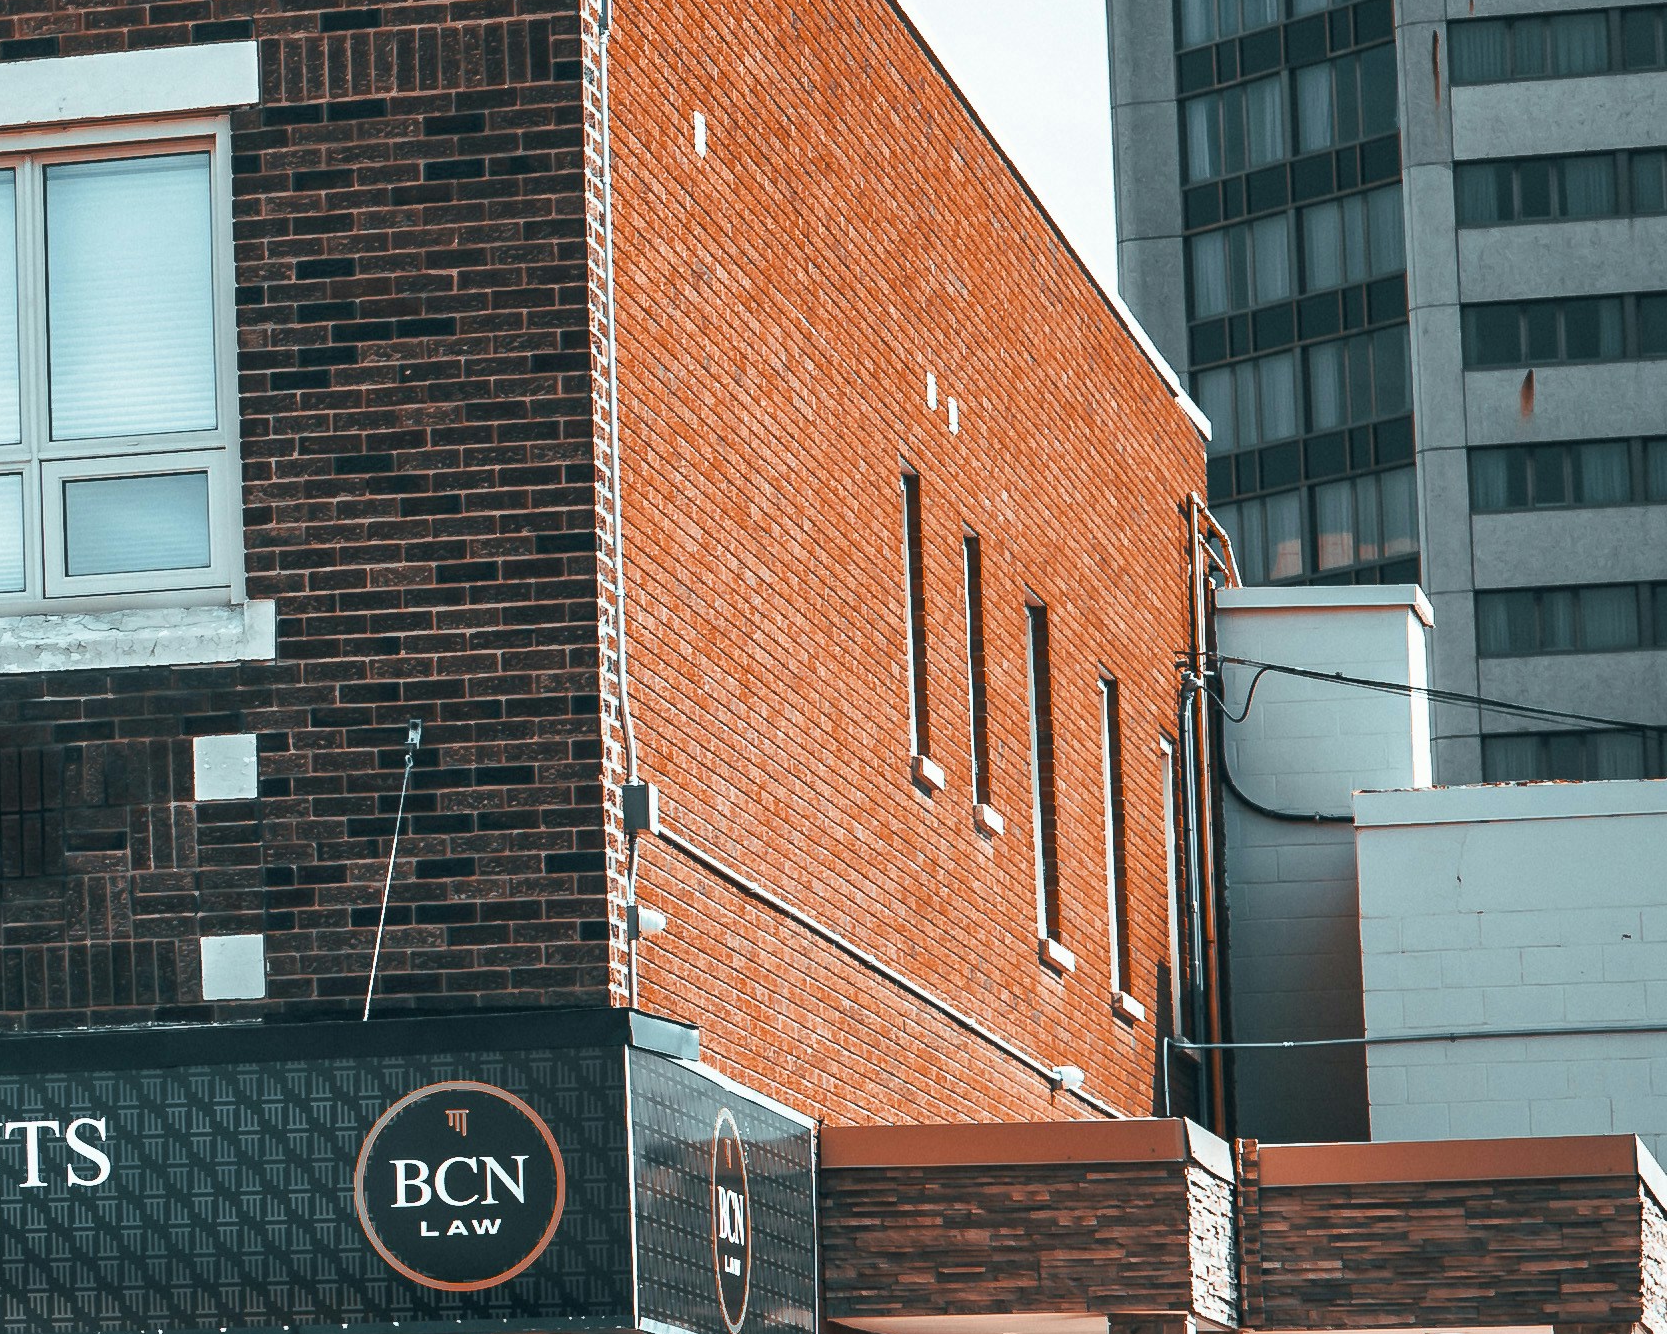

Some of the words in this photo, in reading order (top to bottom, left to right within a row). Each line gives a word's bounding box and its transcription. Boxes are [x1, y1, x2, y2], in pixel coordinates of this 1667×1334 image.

[388, 1153, 528, 1212] BCN
[420, 1217, 503, 1240] LAW
[717, 1185, 745, 1247] BCN
